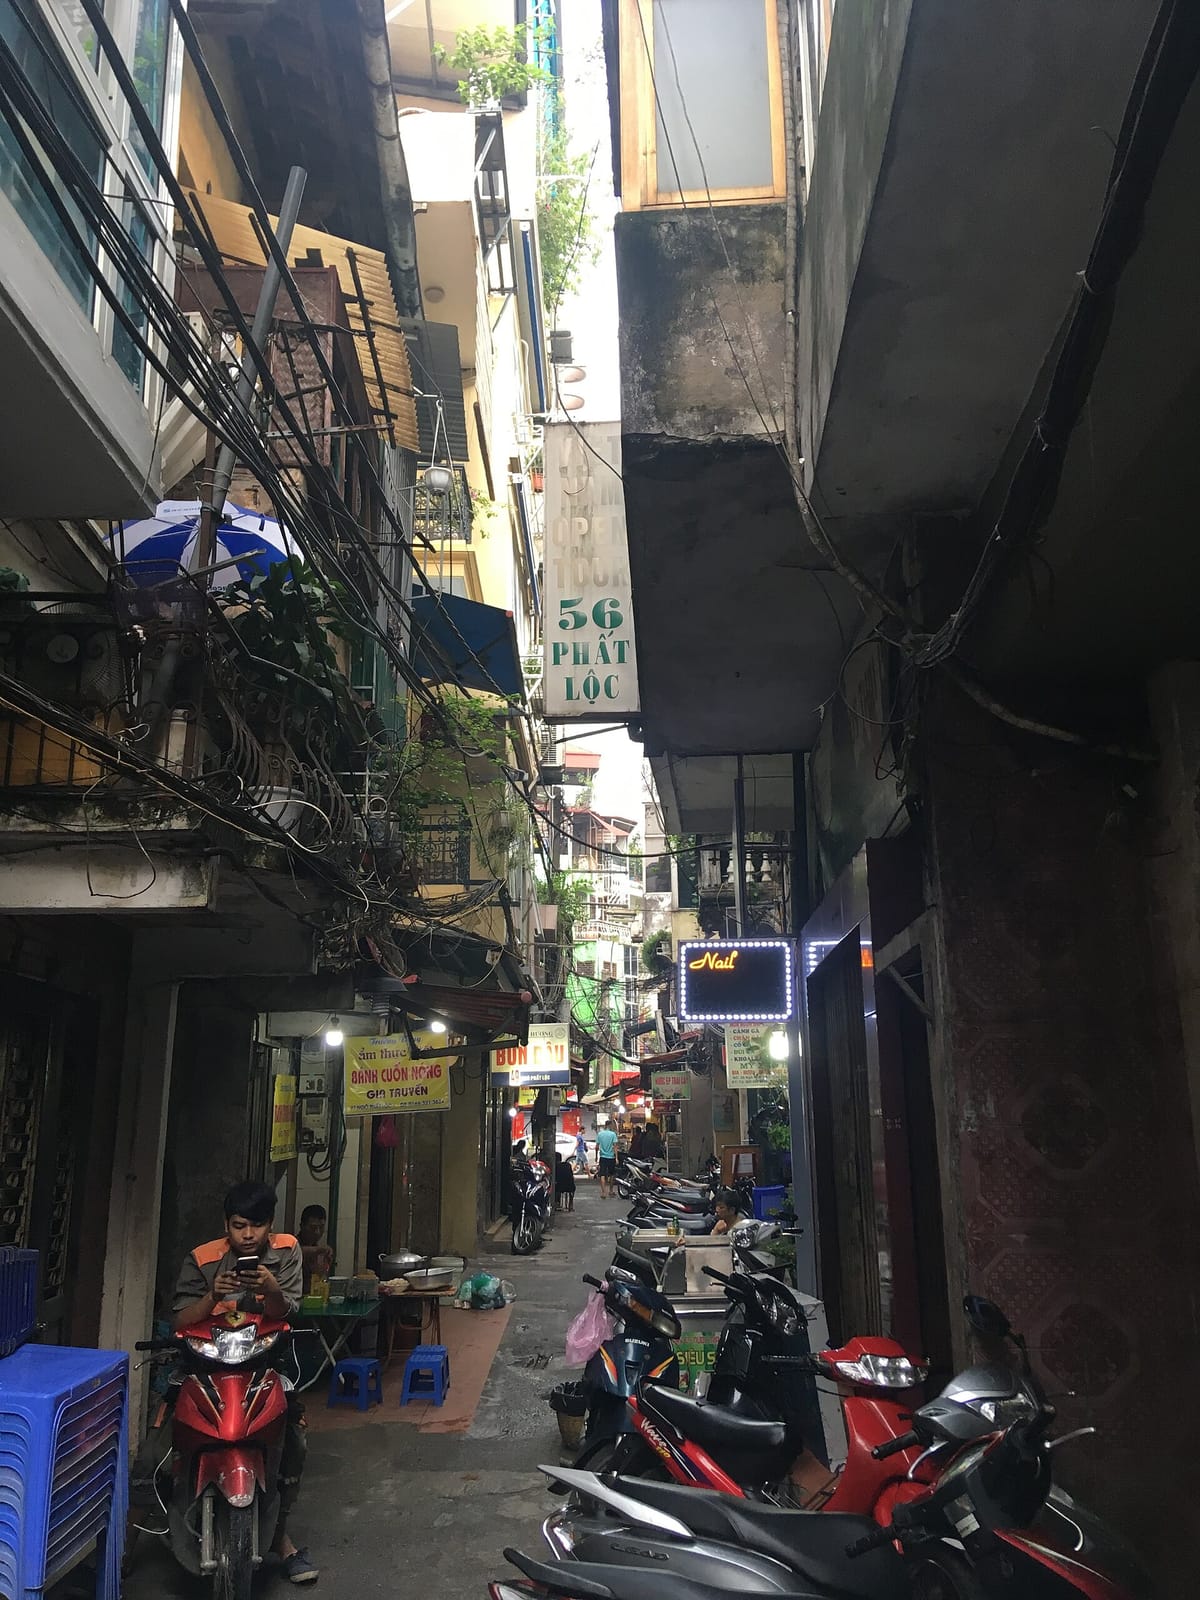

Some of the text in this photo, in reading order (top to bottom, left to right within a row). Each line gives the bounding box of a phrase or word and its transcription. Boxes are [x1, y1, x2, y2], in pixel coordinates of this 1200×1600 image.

[558, 597, 624, 631] 56
[551, 630, 630, 666] PHẤT
[564, 669, 620, 705] LỘC
[688, 949, 739, 972] Nail
[624, 1337, 650, 1348] SUZUKI
